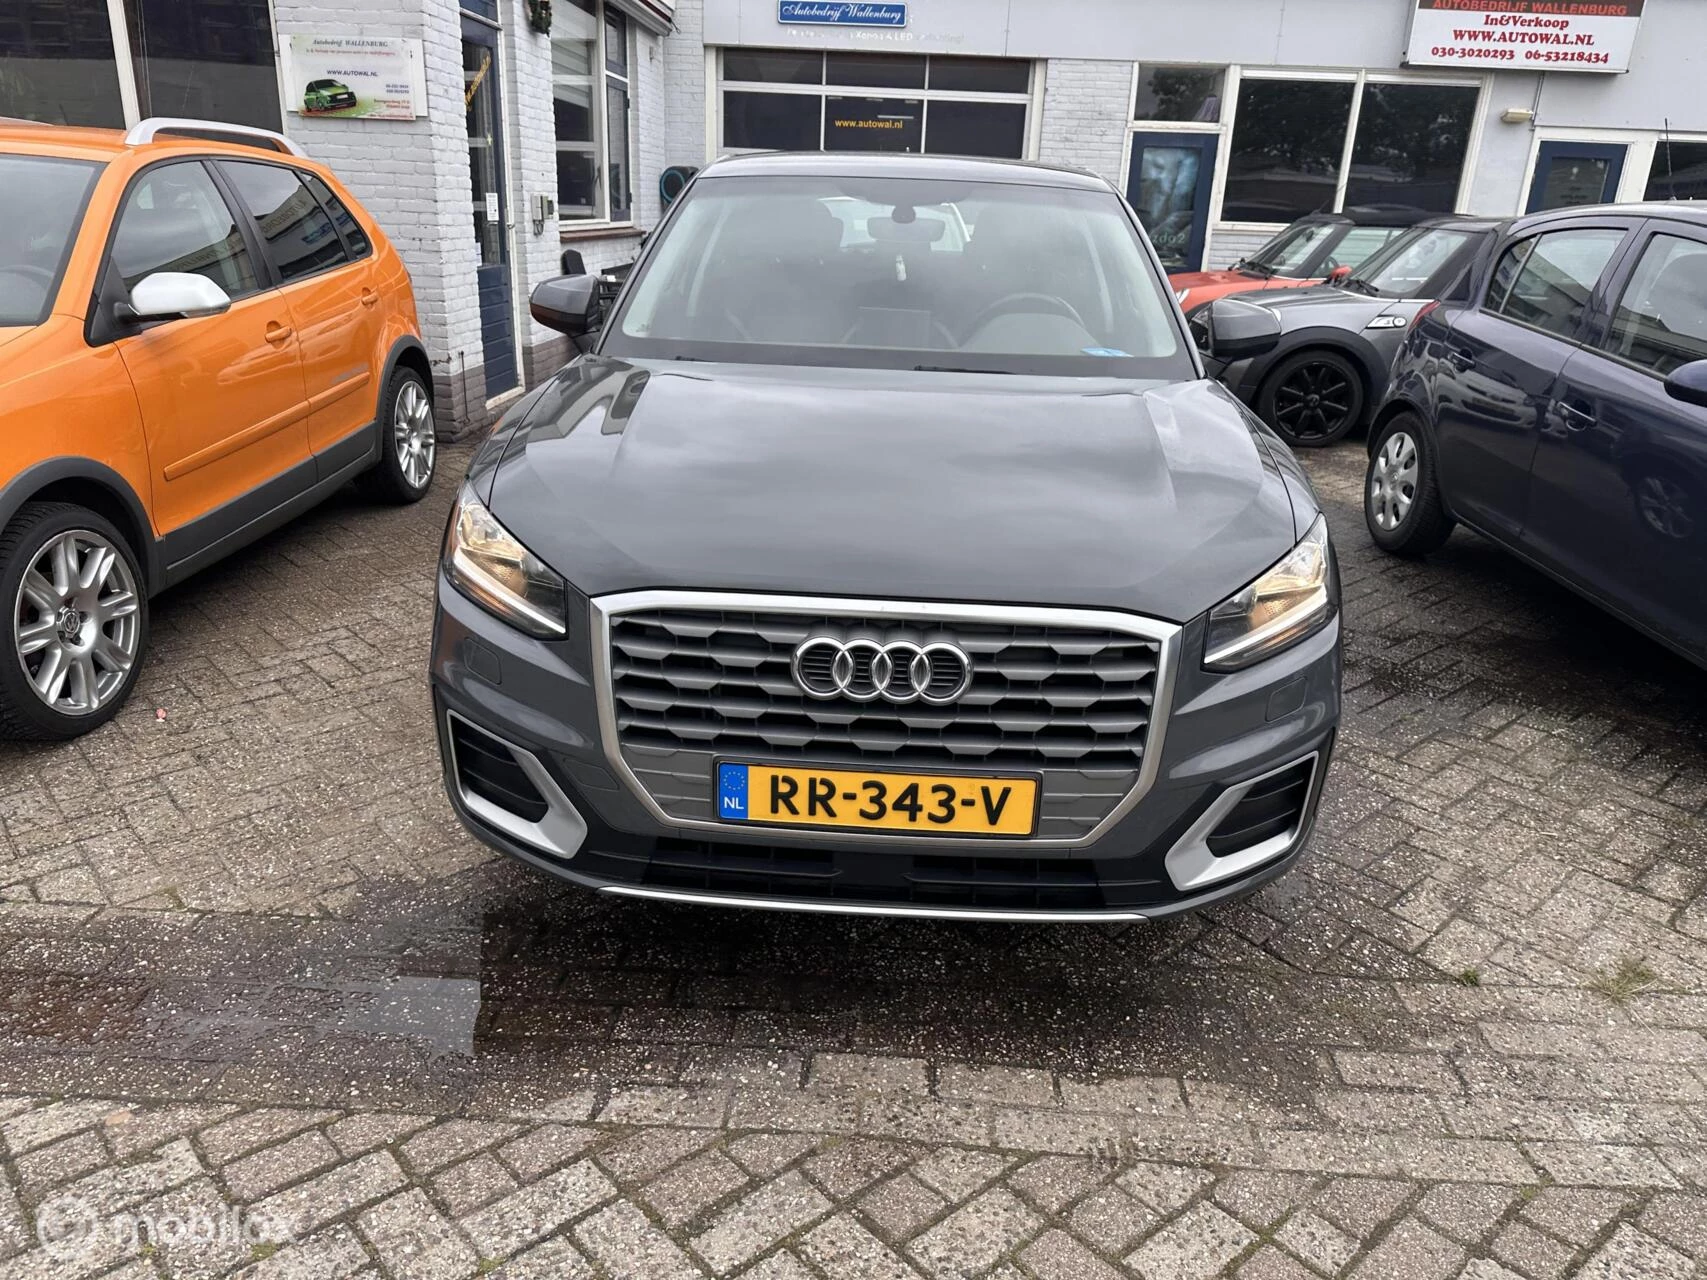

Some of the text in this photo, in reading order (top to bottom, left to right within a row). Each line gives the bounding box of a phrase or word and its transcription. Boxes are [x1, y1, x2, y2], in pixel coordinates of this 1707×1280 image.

[782, 4, 902, 23] Autobedrijf Wallenburg
[1432, 0, 1628, 16] AUTOBEDRIJF WALLENBURG
[1453, 30, 1595, 46] WWW.AUTOWAL.NL
[1431, 46, 1609, 64] 030-3020293 06-53218434
[326, 69, 378, 77] WWW.AUTOWAL.NL
[834, 120, 903, 129] www.autowal.nl
[723, 796, 745, 810] NL
[769, 774, 1012, 826] RR-343-V
